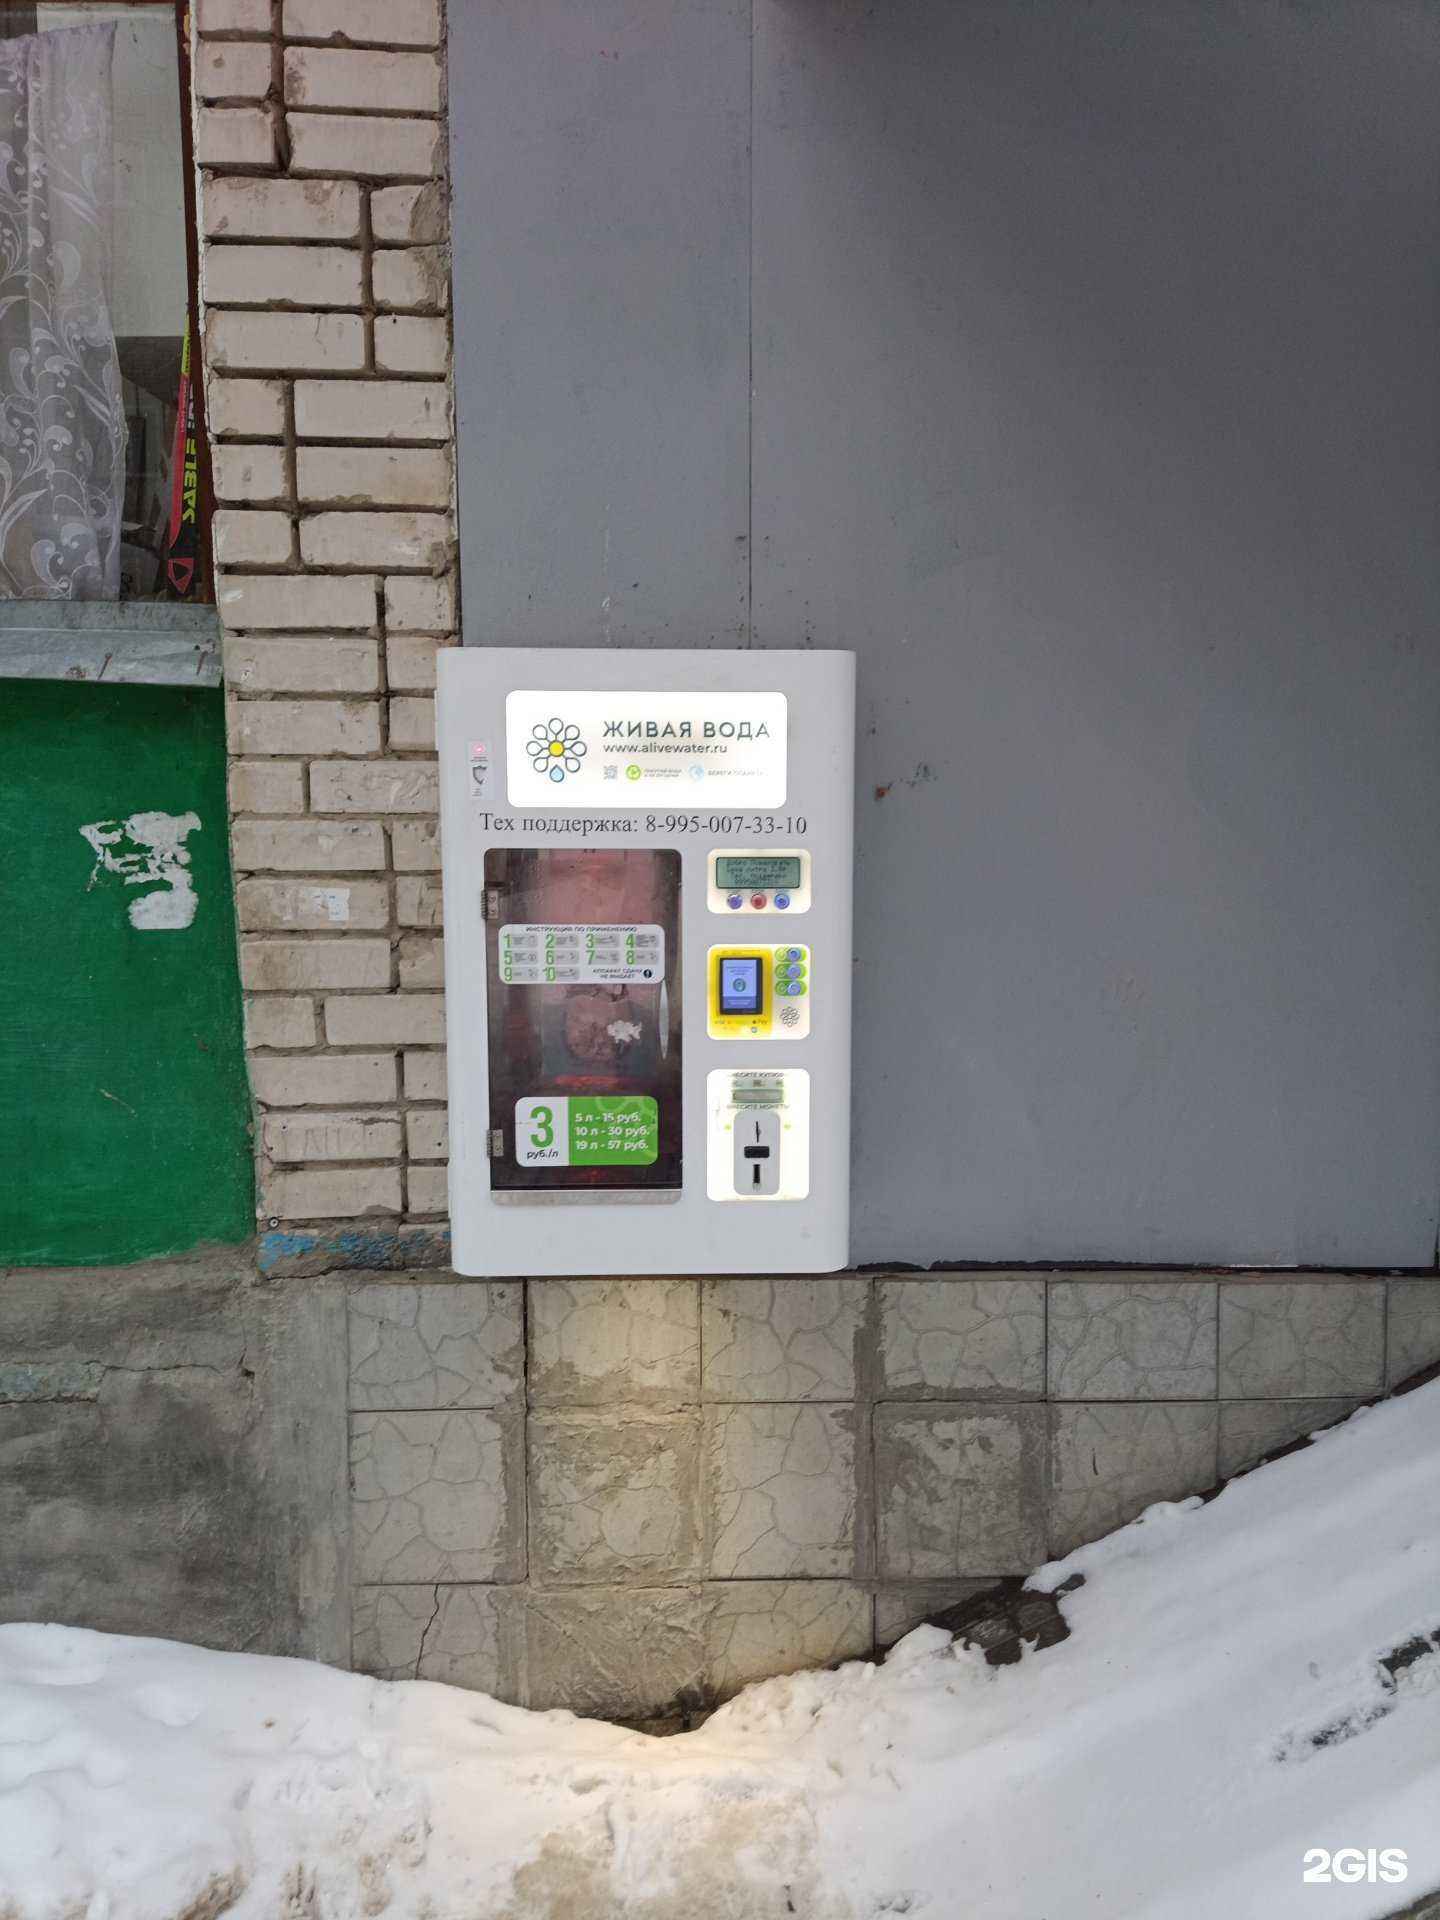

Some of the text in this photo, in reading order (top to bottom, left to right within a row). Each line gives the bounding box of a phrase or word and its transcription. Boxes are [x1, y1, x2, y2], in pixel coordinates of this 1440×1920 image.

[602, 720, 770, 741] ЖИВАЯ ВОДА
[602, 742, 728, 754] www.alivewater.ru
[479, 812, 807, 836] Тех поддержка: 8-995-007-33-10
[504, 934, 513, 949] 1
[545, 934, 555, 949] 2
[585, 934, 595, 949] 3
[625, 934, 636, 949] 4
[504, 950, 513, 965] 5
[545, 950, 554, 965] 6
[586, 950, 595, 965] 7
[626, 950, 635, 965] 8
[504, 967, 513, 982] 9
[542, 967, 556, 982] 10
[575, 1113, 583, 1122] 5
[585, 1114, 593, 1122] л
[602, 1113, 615, 1122] 15
[616, 1111, 641, 1124] руб.
[530, 1105, 554, 1149] 3
[575, 1127, 588, 1136] 10
[590, 1128, 598, 1136] л
[607, 1126, 622, 1136] 30
[625, 1125, 650, 1137] руб.
[575, 1140, 588, 1150] 19
[590, 1142, 598, 1150] л
[607, 1140, 622, 1150] 57
[624, 1139, 649, 1151] руб.
[527, 1148, 559, 1160] руб./л
